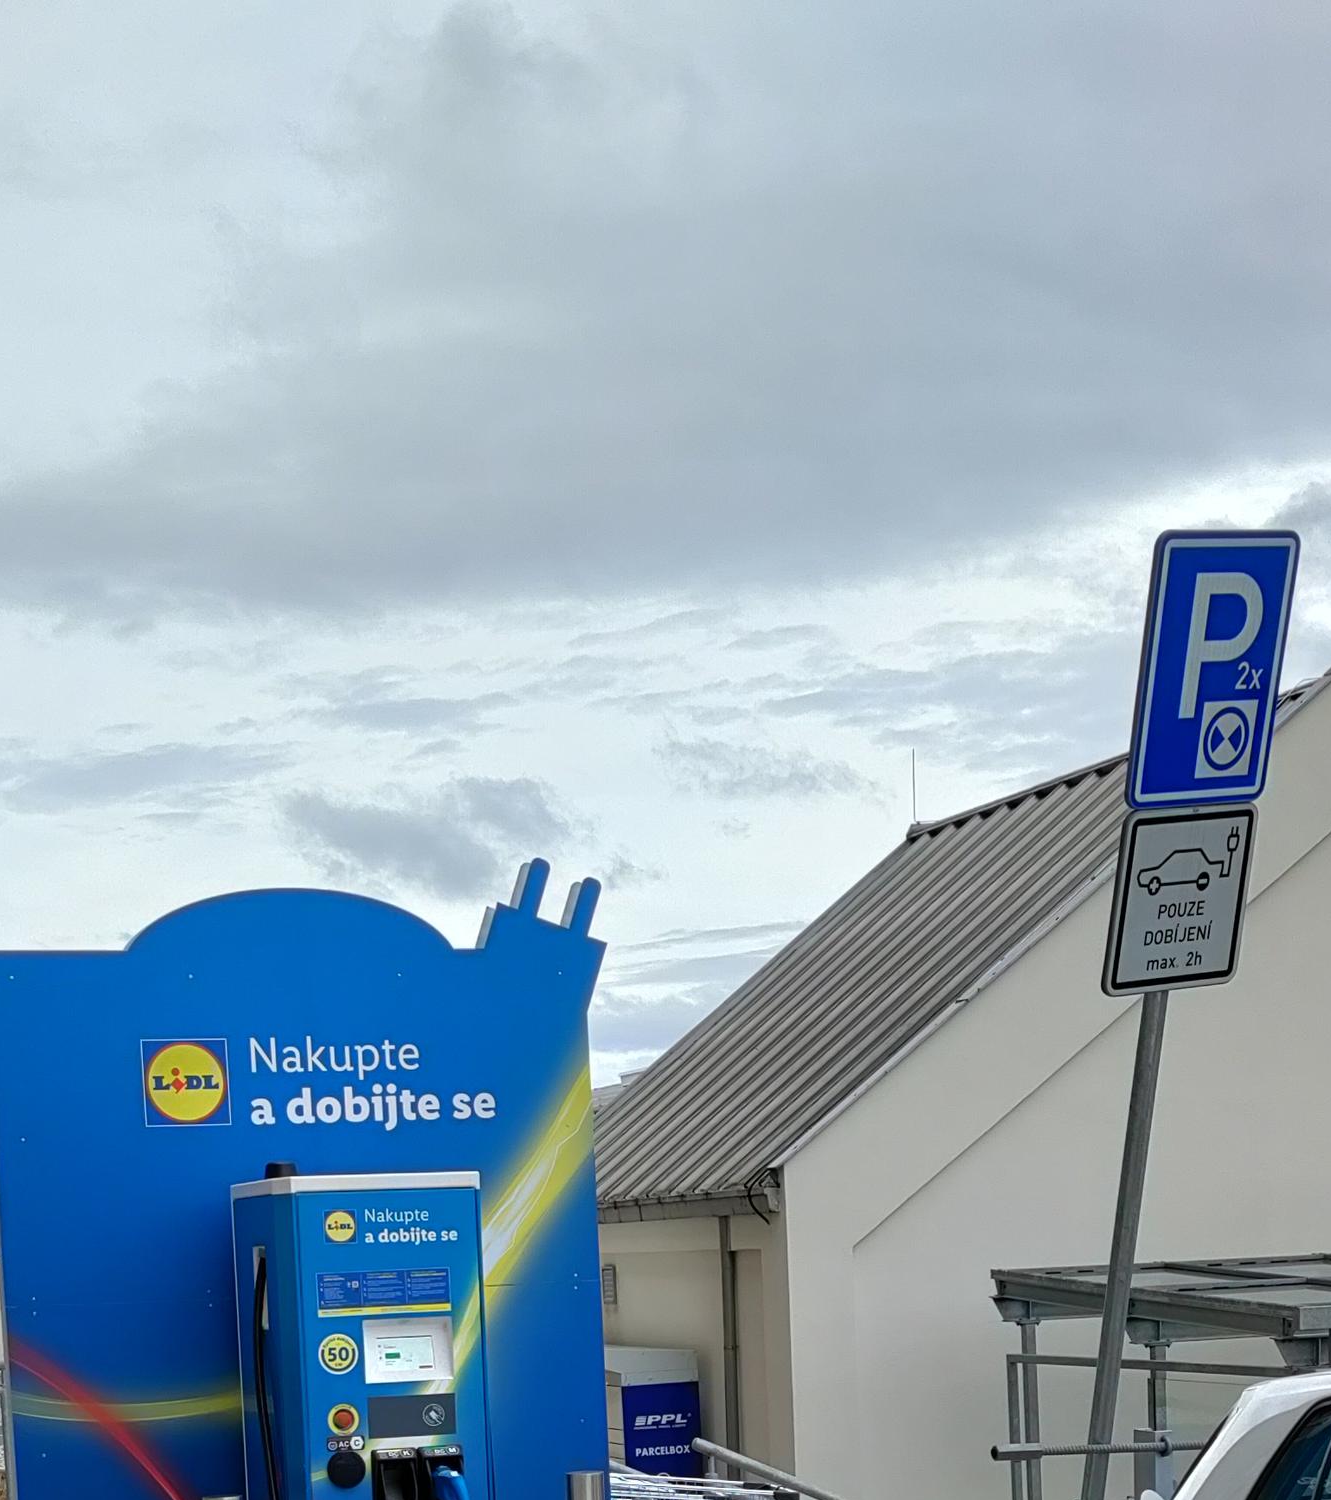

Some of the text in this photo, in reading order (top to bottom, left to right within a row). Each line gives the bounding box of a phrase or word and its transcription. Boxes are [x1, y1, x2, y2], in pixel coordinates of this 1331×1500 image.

[1178, 571, 1264, 719] P
[1235, 661, 1264, 690] 2x
[1157, 900, 1206, 919] POUZE
[1144, 920, 1213, 946] DOBÍJENÍ
[1146, 951, 1203, 972] max. 2h
[248, 1035, 420, 1080] Nakupte
[250, 1083, 496, 1131] a dobijte se
[364, 1208, 429, 1225] Nakupte
[364, 1227, 458, 1245] a dobijte se
[328, 1346, 350, 1362] 50
[353, 1439, 361, 1447] C
[635, 1444, 691, 1457] PARCELBOX
